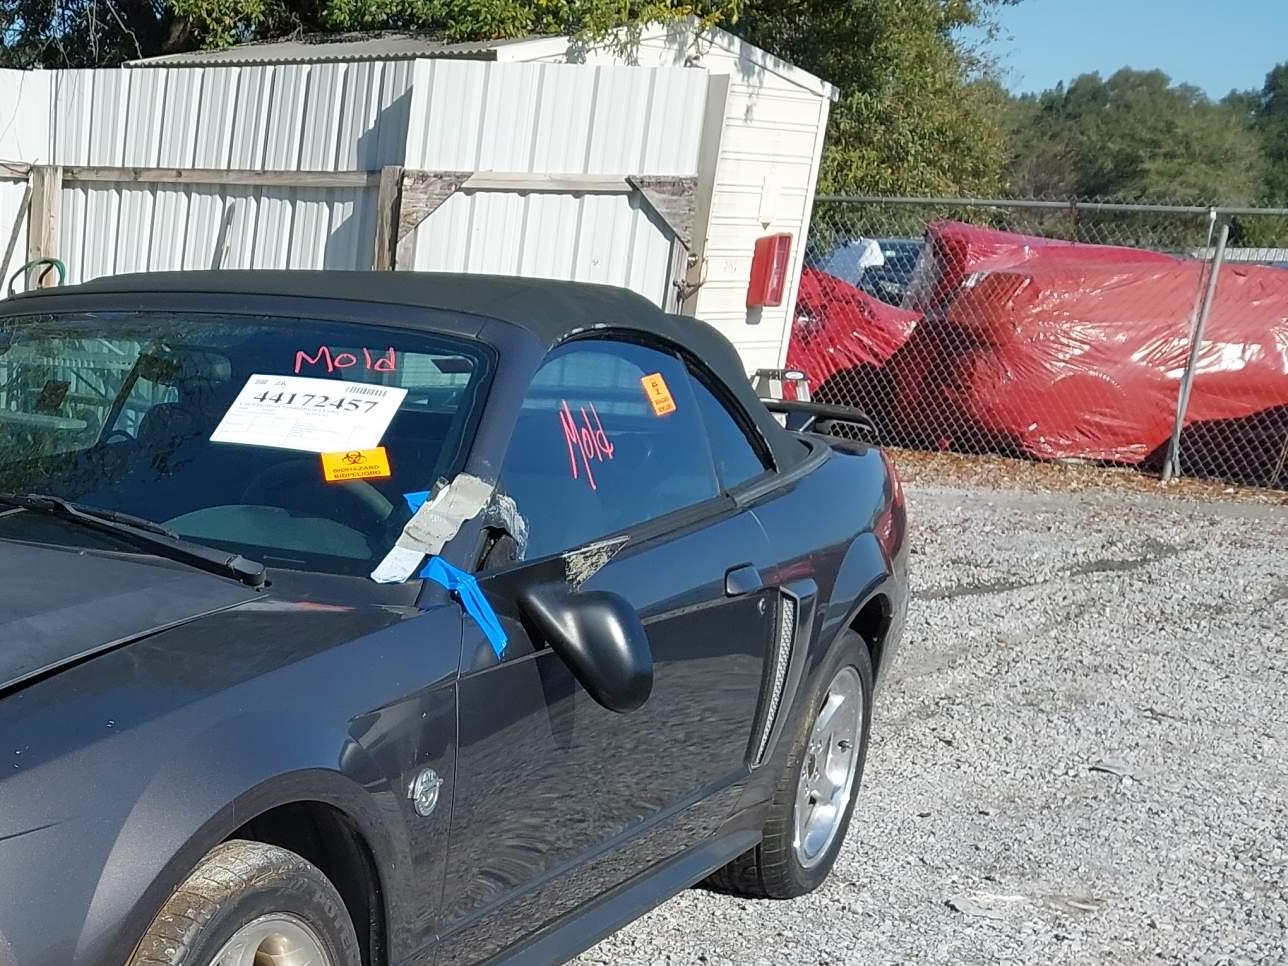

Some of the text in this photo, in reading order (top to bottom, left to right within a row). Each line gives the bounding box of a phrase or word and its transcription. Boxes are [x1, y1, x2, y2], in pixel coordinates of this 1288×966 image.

[294, 345, 397, 374] Mold
[253, 390, 379, 414] 44172457
[559, 399, 614, 490] Mold
